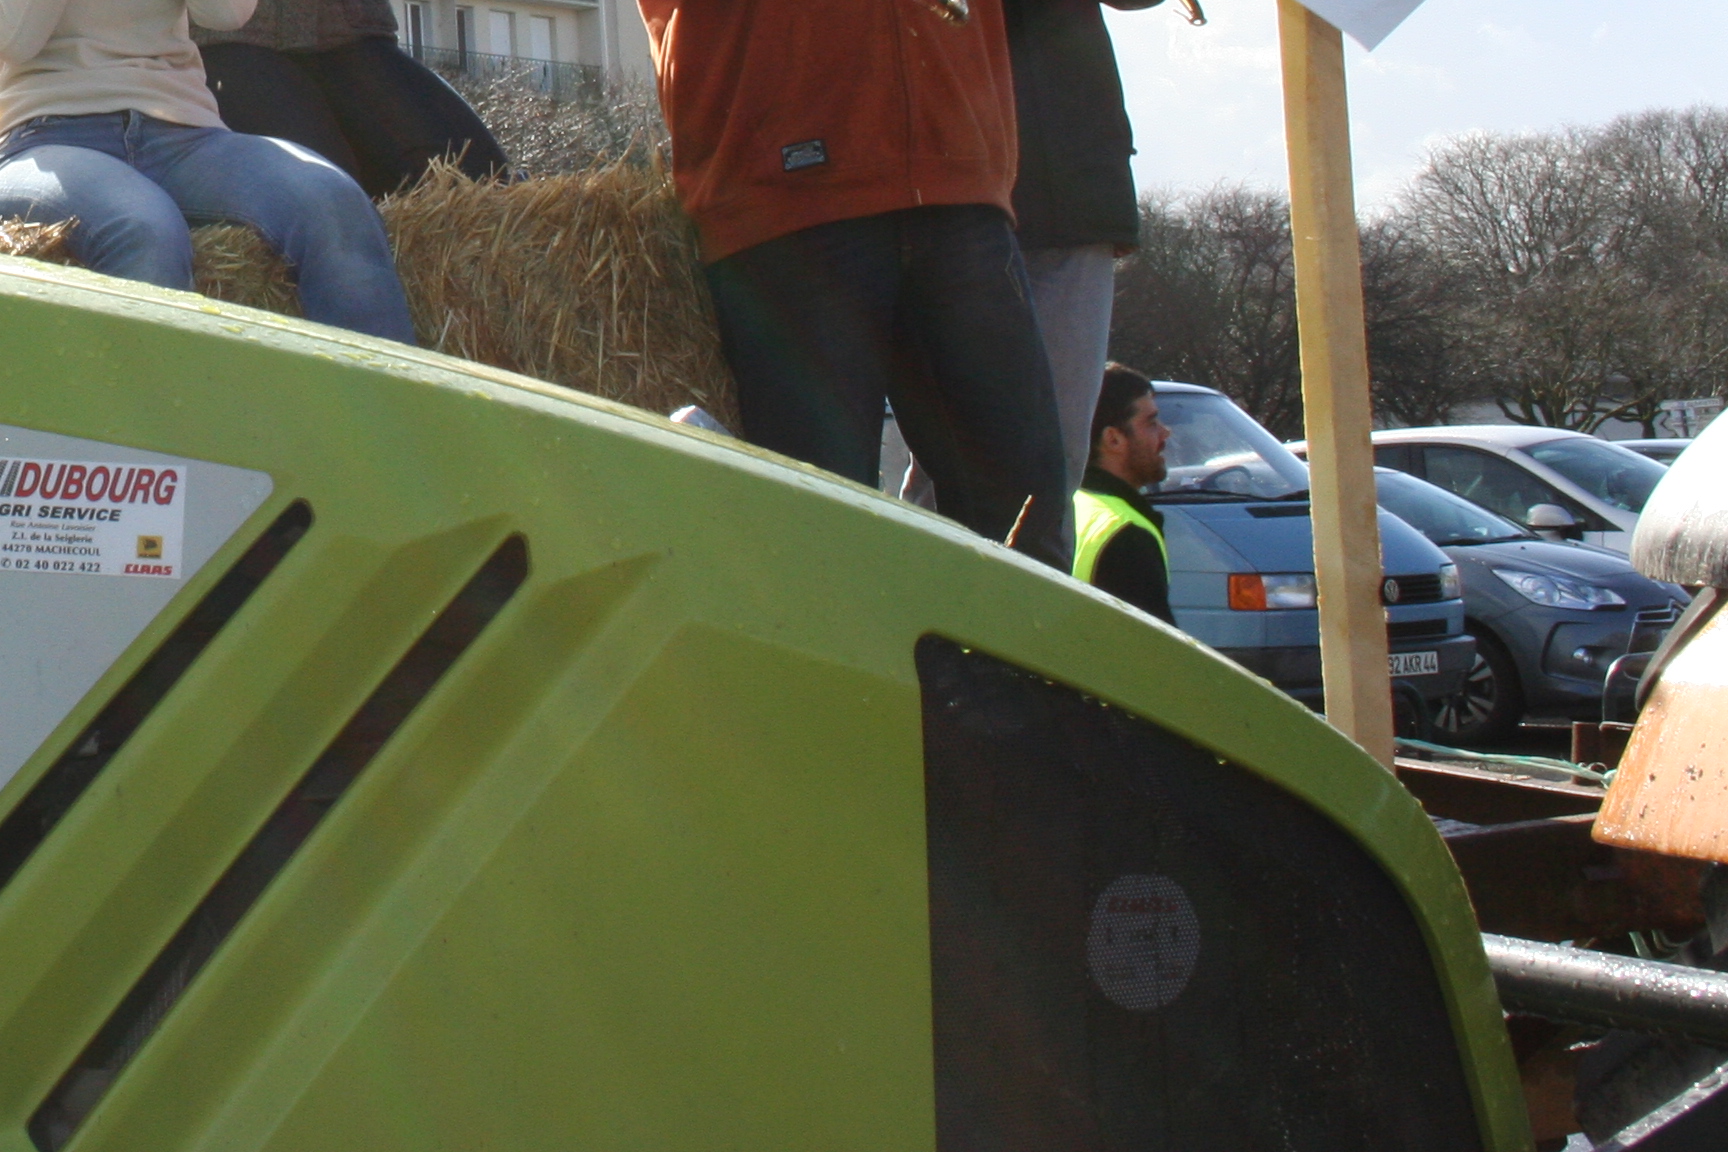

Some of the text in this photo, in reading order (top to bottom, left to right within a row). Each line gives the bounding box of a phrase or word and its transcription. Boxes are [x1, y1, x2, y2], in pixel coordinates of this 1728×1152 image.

[14, 462, 178, 505] DUBOURG
[38, 505, 122, 522] SERVICE
[30, 532, 41, 541] de
[44, 533, 52, 541] la
[35, 545, 101, 556] MACHECOUL
[15, 559, 101, 572] 02 40 022 422
[124, 563, 173, 575] CLAAS
[1403, 654, 1421, 673] AKR
[1424, 653, 1436, 671] 44
